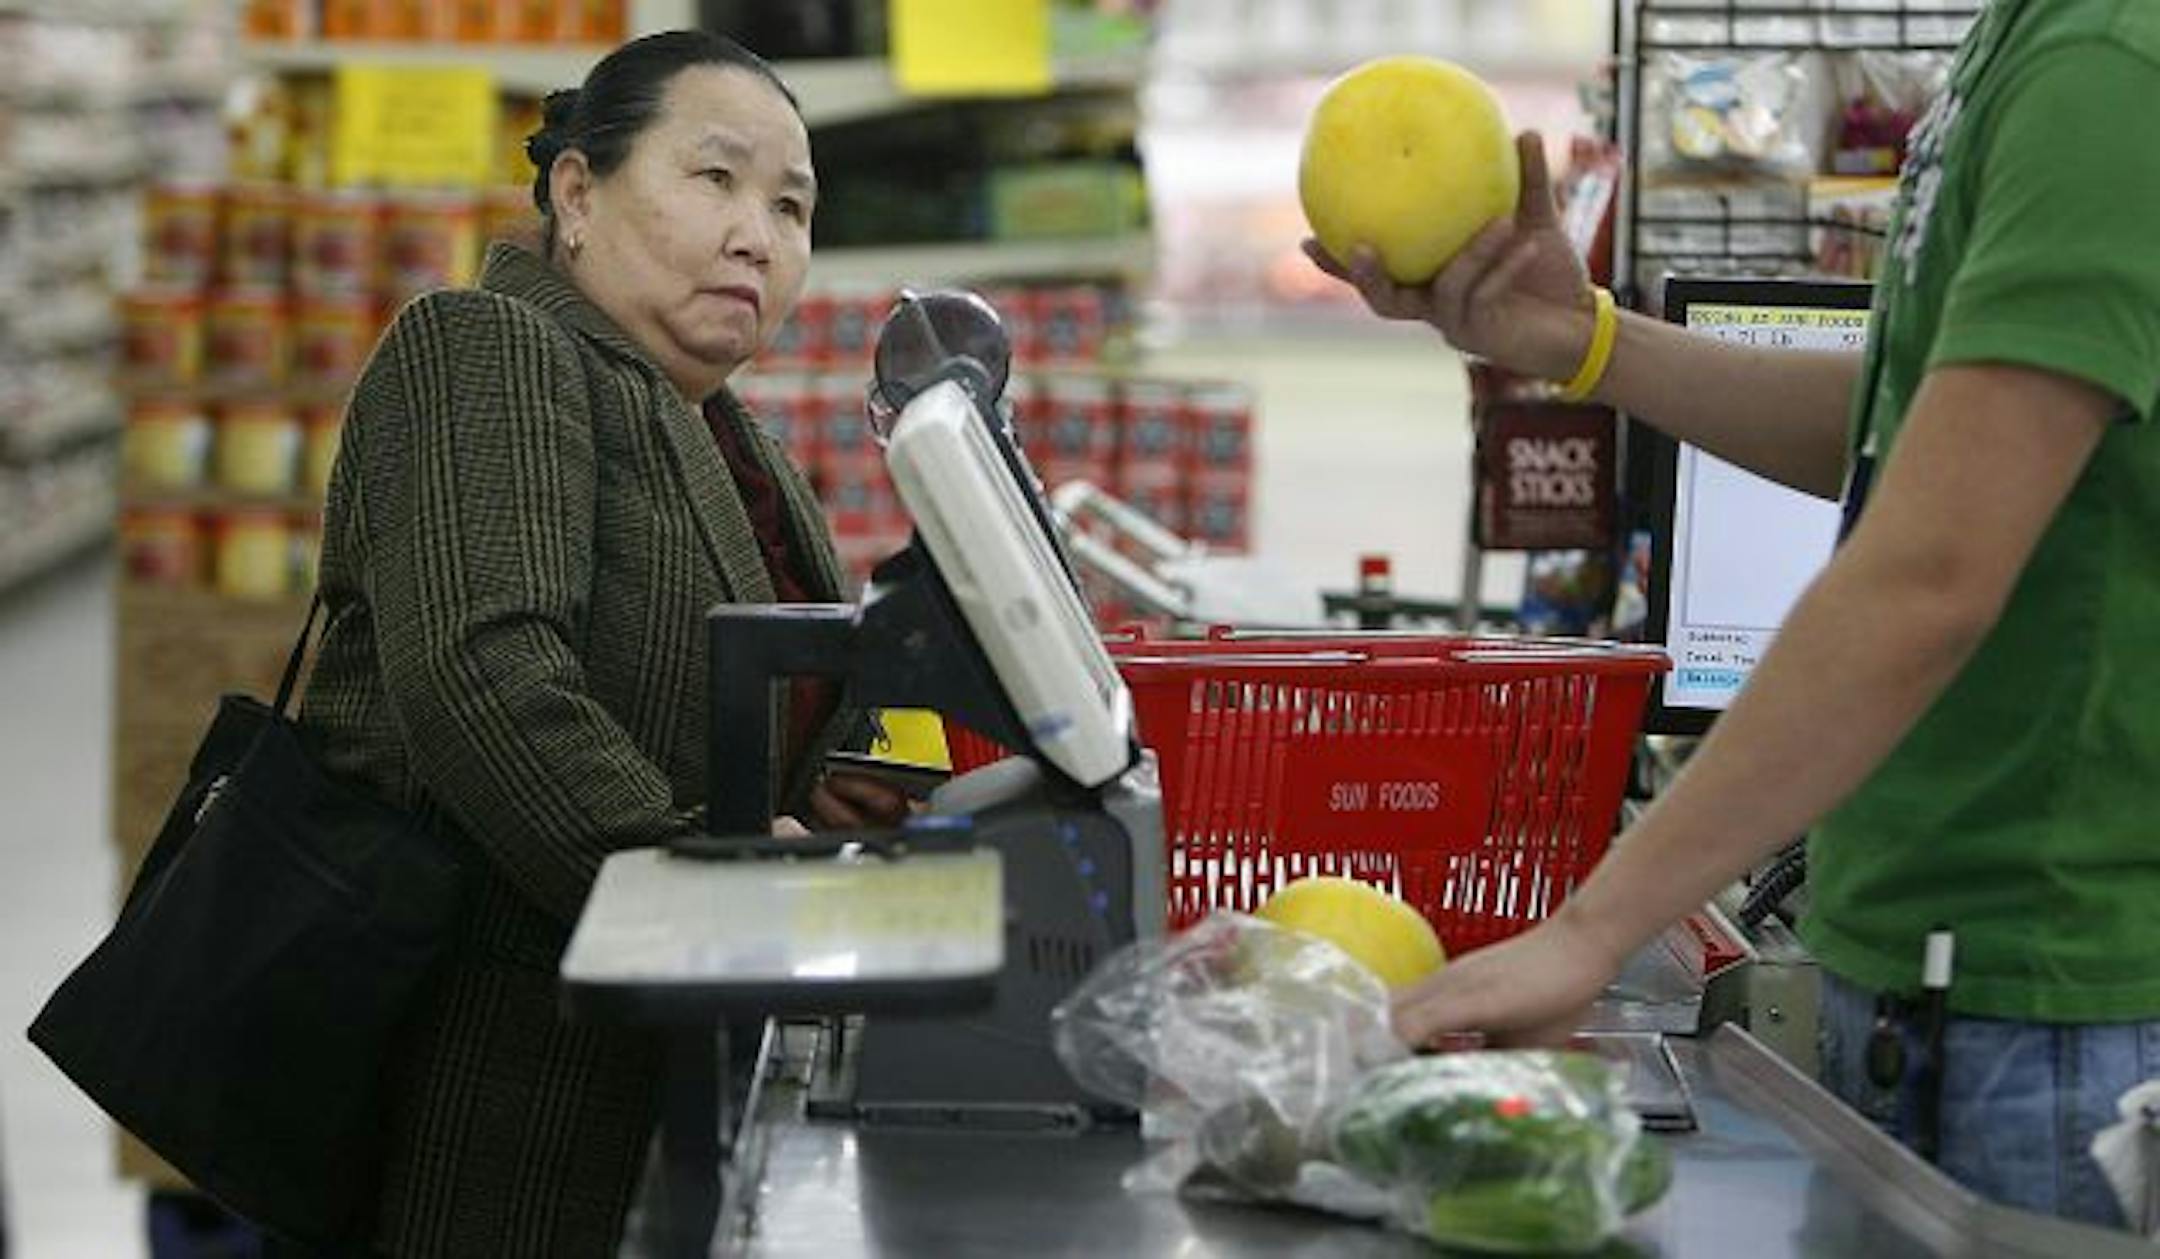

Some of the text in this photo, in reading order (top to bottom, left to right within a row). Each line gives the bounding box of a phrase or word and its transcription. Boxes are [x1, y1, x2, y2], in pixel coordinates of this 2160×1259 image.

[1507, 437, 1598, 469] SNACK
[1510, 471, 1595, 505] STICKS
[1328, 781, 1440, 812] SUN FOODS
